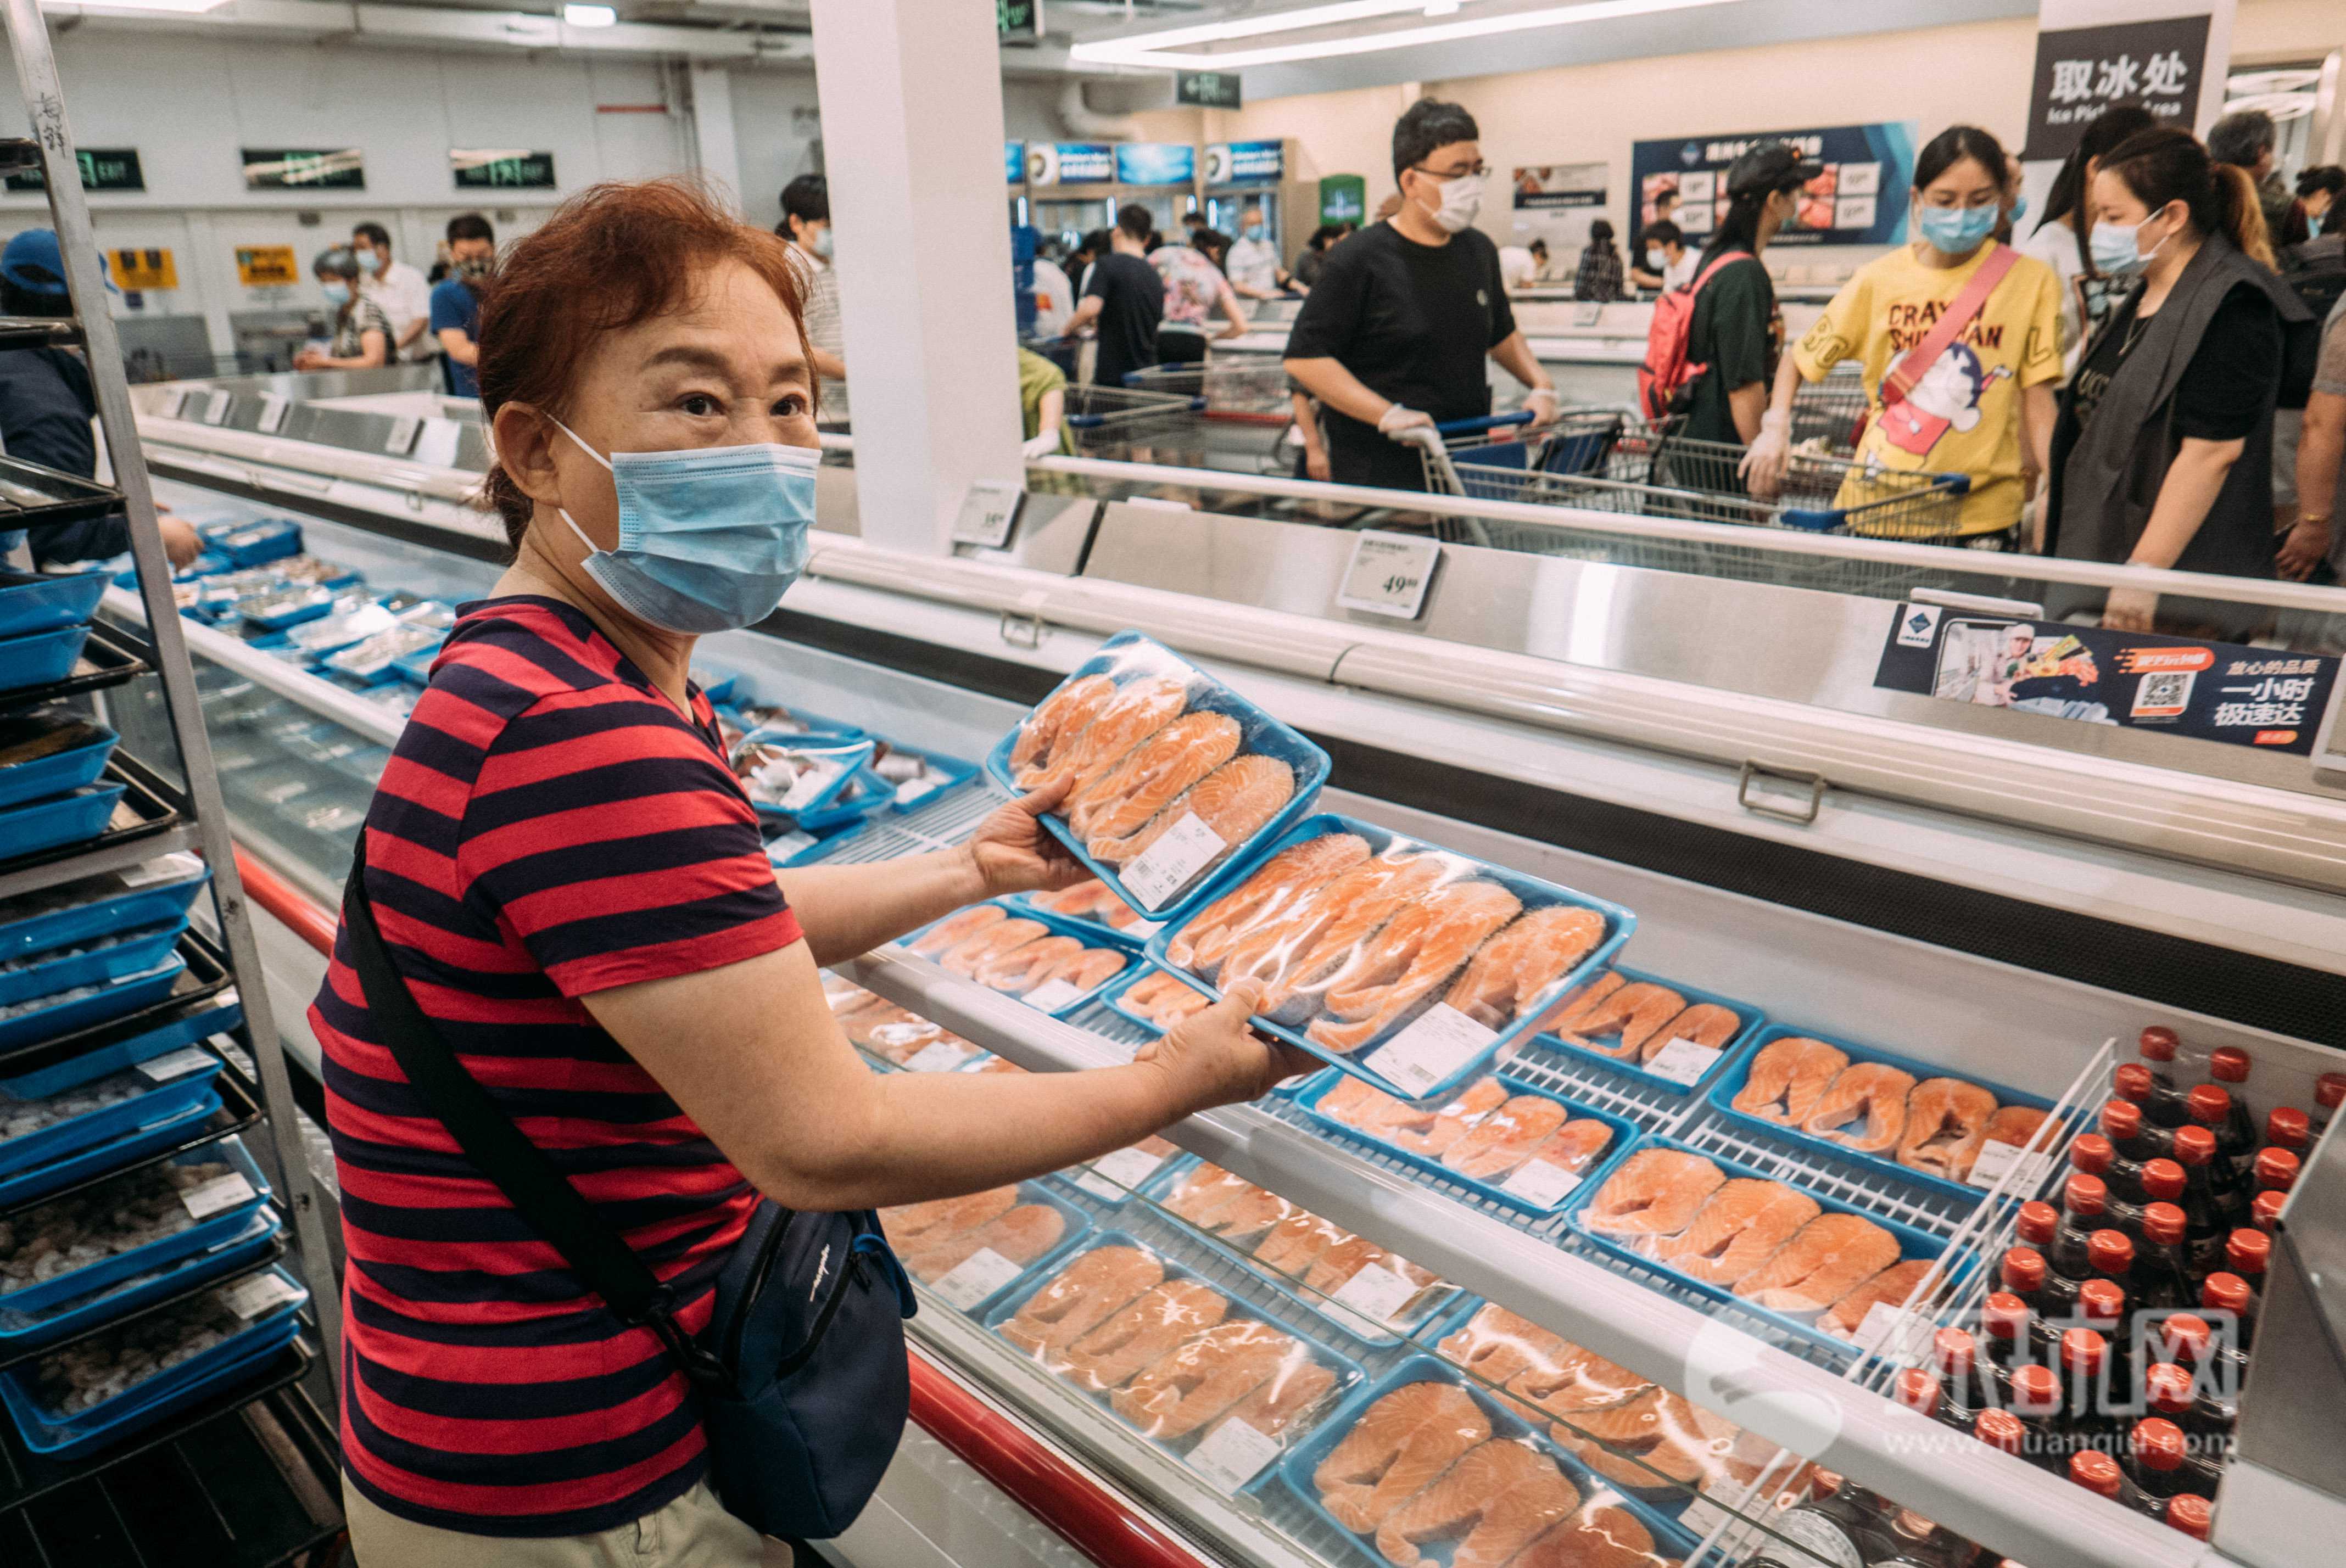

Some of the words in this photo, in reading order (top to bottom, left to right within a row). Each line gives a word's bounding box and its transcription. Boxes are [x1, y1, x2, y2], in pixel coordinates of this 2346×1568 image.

[2049, 50, 2188, 103] 取冰处
[2047, 108, 2073, 125] Ice
[2227, 659, 2321, 675] 放心的品质
[2221, 677, 2314, 702] 一小时
[2215, 702, 2305, 726] 极速达
